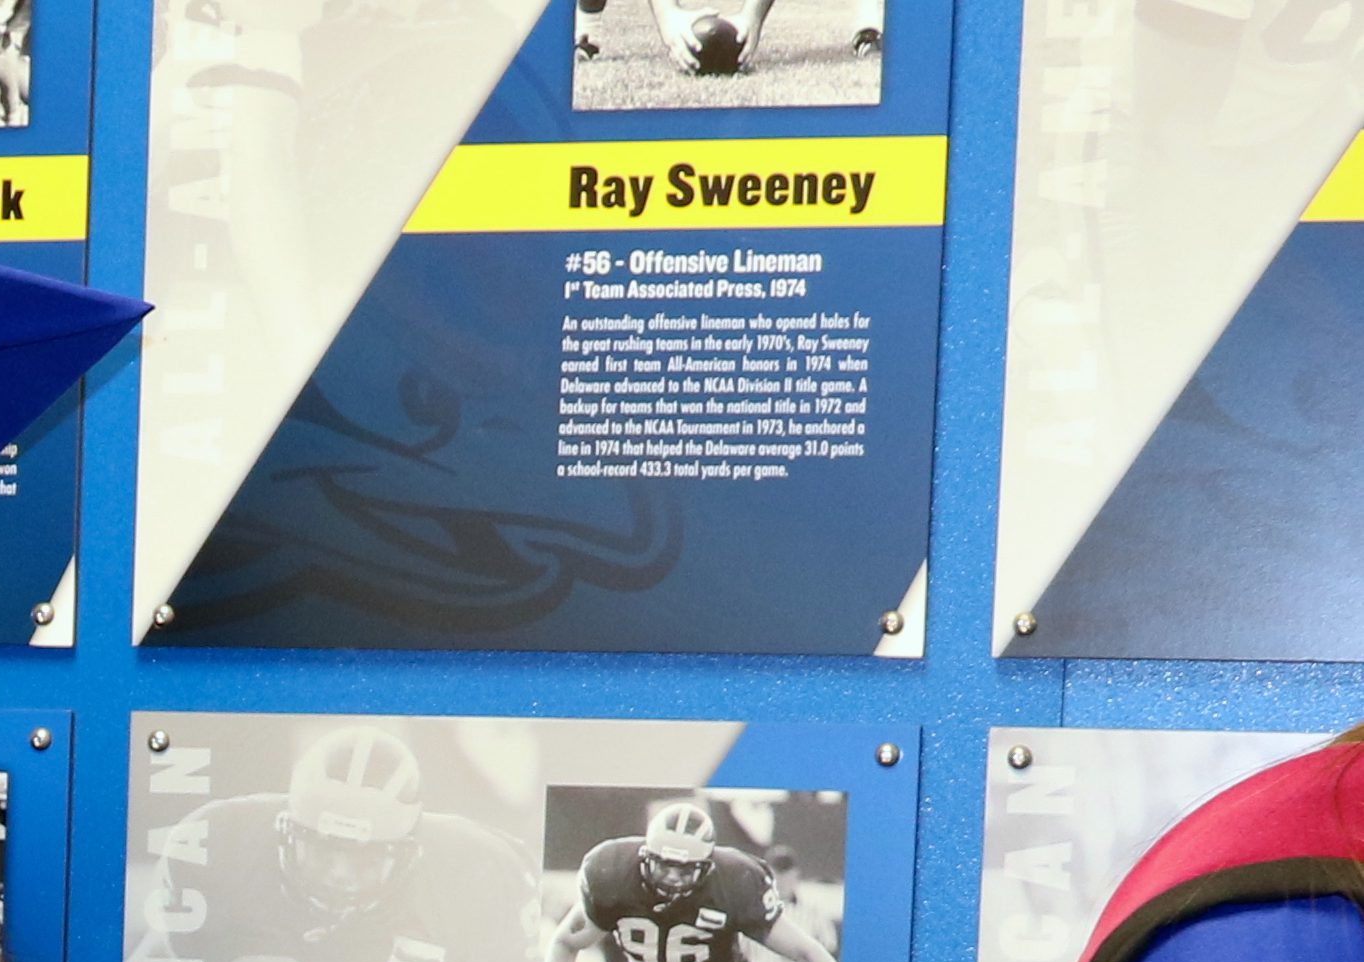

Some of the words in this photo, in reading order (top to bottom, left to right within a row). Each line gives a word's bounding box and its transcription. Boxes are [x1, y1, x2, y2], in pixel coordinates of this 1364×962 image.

[569, 166, 654, 218] Ray
[666, 163, 875, 215] Sweeney
[565, 250, 611, 275] #56
[629, 249, 729, 274] Offensive
[733, 249, 822, 273] Lineman
[564, 281, 580, 299] 1st
[582, 280, 625, 299] Team
[626, 279, 714, 298] Associated
[715, 279, 766, 299] Press,
[769, 278, 806, 298] 1974
[562, 315, 578, 330] An
[580, 313, 645, 334] outstanding
[647, 312, 697, 330] offensive
[700, 313, 745, 330] lineman
[748, 312, 773, 329] who
[775, 312, 817, 332] opened
[819, 312, 850, 329] holes
[853, 311, 870, 329] for
[561, 335, 580, 352] the
[581, 338, 611, 356] great
[612, 334, 653, 355] rushing
[655, 337, 688, 351] teams
[690, 335, 702, 350] in
[703, 334, 723, 351] the
[724, 334, 753, 354] early
[796, 334, 819, 353] Ray
[821, 334, 869, 353] Sweeney
[560, 355, 599, 372] earned
[605, 355, 627, 372] first
[633, 358, 661, 372] team
[666, 355, 736, 372] All-American
[742, 354, 780, 372] honors
[785, 356, 797, 371] in
[805, 355, 831, 371] 1974
[837, 354, 868, 371] when
[560, 376, 611, 394] Delaware
[613, 376, 665, 393] advanced
[667, 379, 679, 393] to
[682, 376, 701, 393] the
[703, 376, 735, 393] NCAA
[737, 377, 781, 393] Division
[795, 375, 817, 393] title
[820, 380, 855, 396] game.
[858, 377, 868, 392] A
[559, 397, 599, 417] backup
[600, 396, 618, 414] for
[619, 400, 653, 414] teams
[655, 397, 678, 414] that
[680, 402, 703, 414] won
[705, 397, 724, 414] the
[726, 397, 772, 414] national
[774, 397, 797, 414] title
[799, 399, 811, 413] in
[815, 395, 842, 414] 1972
[844, 397, 866, 414] and
[558, 418, 609, 435] advanced
[610, 421, 622, 435] to
[624, 418, 642, 435] the
[643, 418, 675, 435] NCAA
[676, 418, 741, 435] Tournament
[741, 420, 753, 435] in
[756, 418, 786, 437] 1973,
[787, 418, 803, 435] he
[804, 418, 855, 435] anchored
[856, 423, 865, 435] a
[557, 439, 579, 456] line
[579, 440, 591, 455] in
[594, 439, 620, 456] 1974
[622, 439, 644, 456] that
[645, 438, 683, 459] helped
[684, 439, 703, 456] the
[704, 439, 756, 456] Delaware
[757, 444, 802, 460] average
[803, 439, 829, 456] 31.0
[829, 441, 864, 459] points
